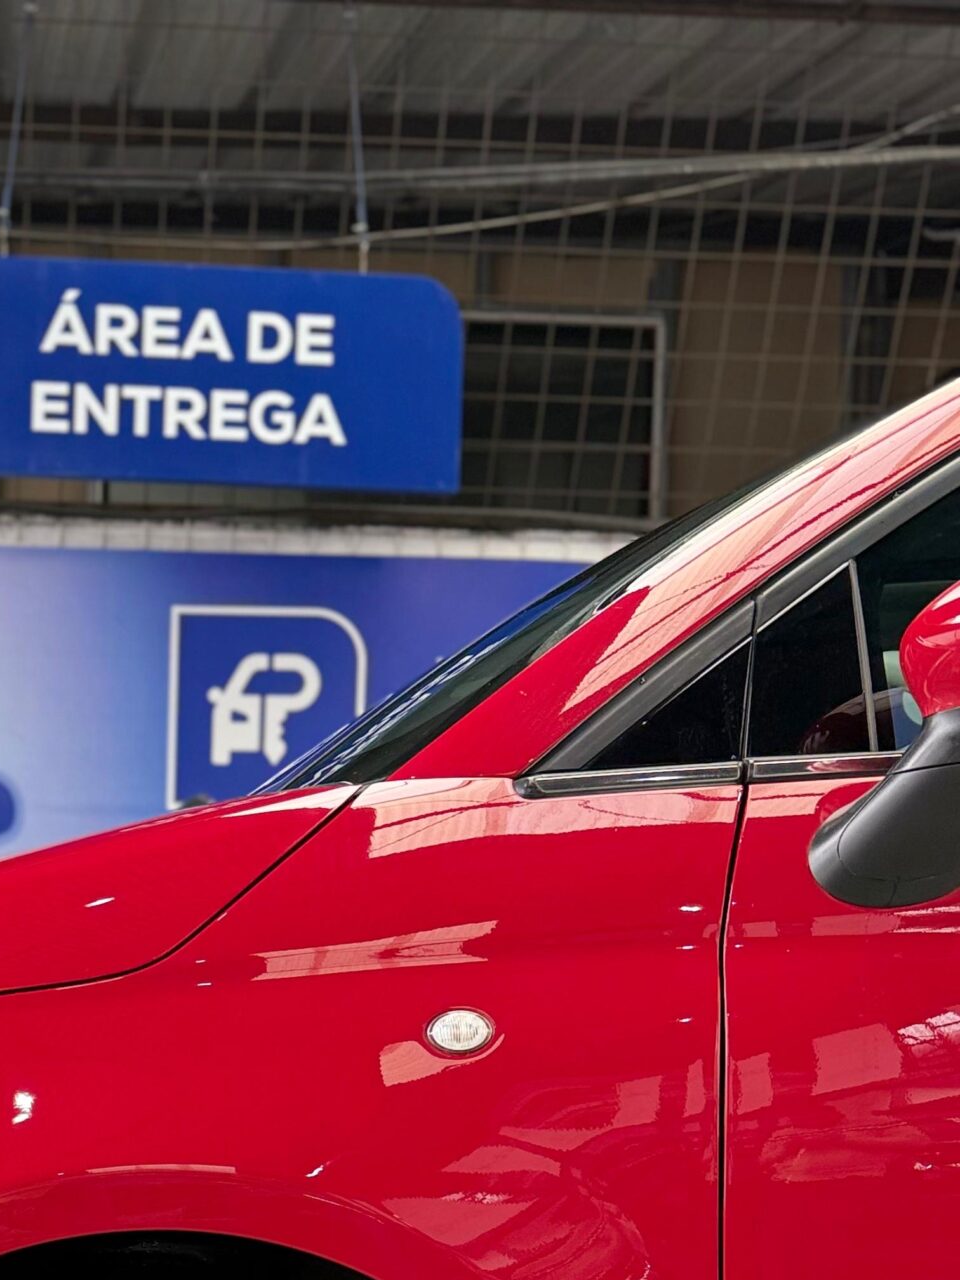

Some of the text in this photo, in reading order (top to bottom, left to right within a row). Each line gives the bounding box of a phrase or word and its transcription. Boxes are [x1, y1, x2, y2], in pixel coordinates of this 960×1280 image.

[40, 288, 336, 366] ÁREA DE
[30, 380, 347, 447] ENTREGA
